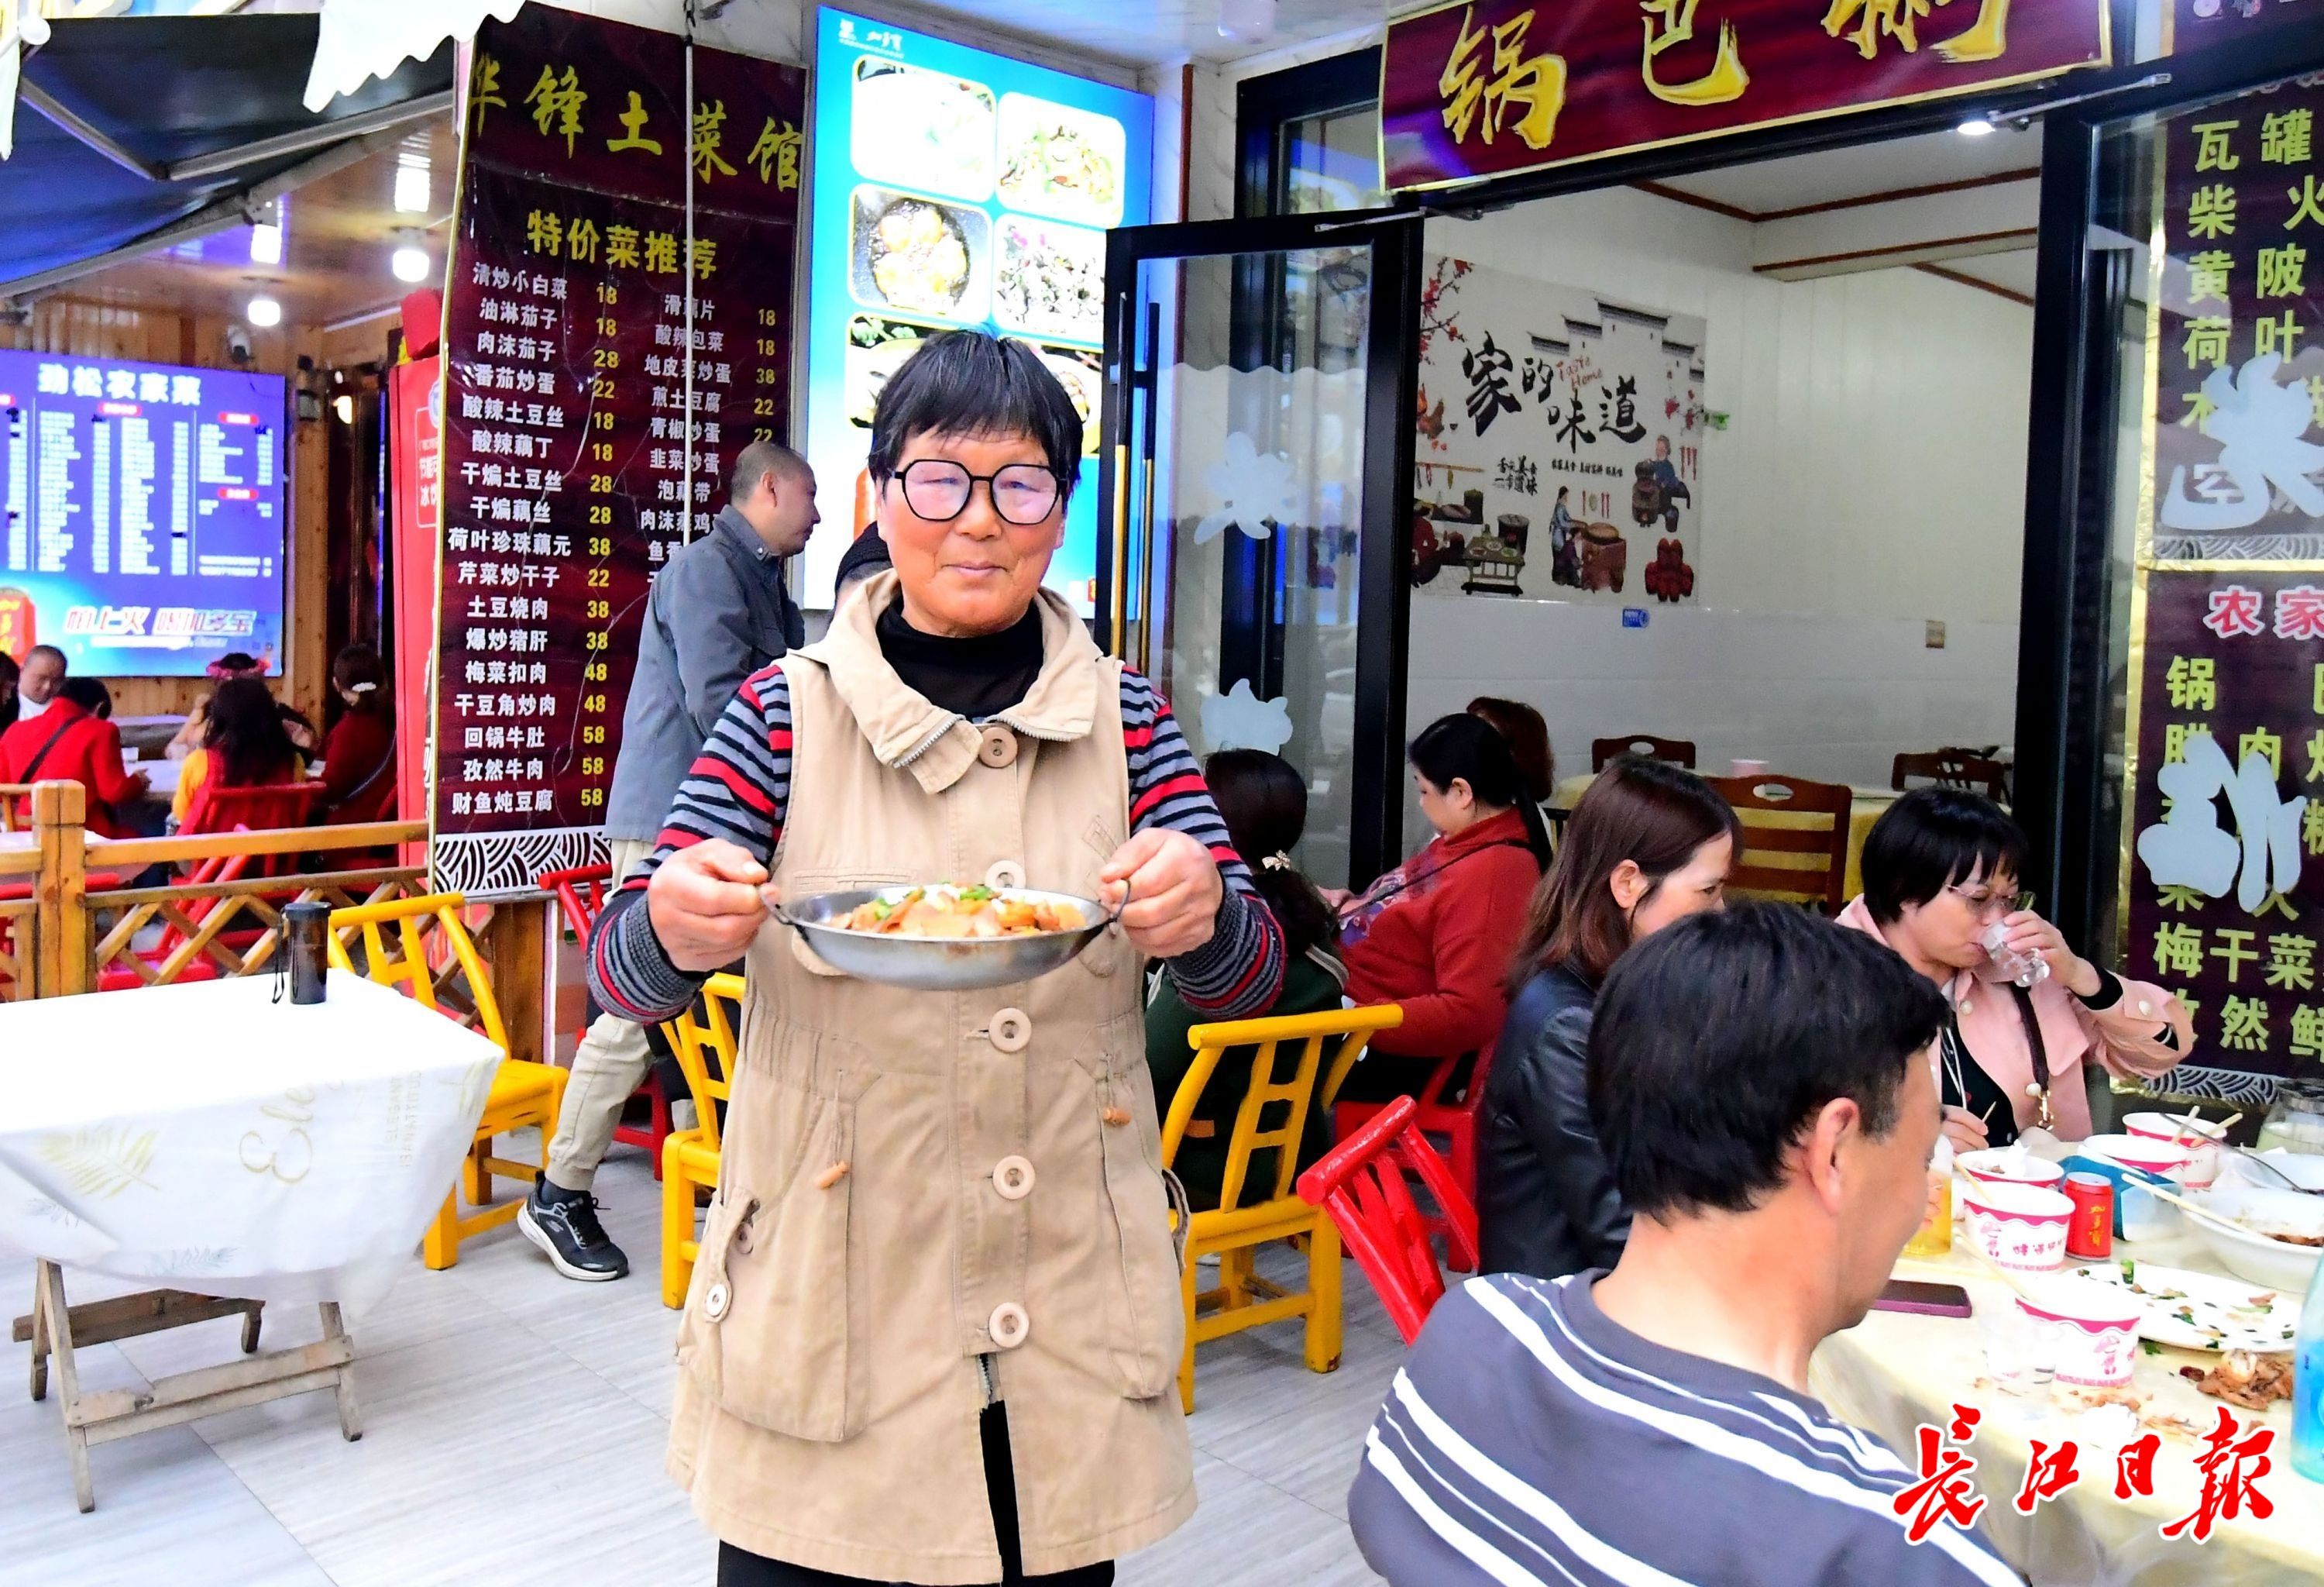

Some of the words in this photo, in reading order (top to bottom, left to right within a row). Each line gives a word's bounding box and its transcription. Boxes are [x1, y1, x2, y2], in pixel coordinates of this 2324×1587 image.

[471, 53, 803, 192] 华锋土菜馆
[2192, 108, 2312, 172] 瓦罐
[527, 209, 717, 279] 特价菜推荐
[473, 262, 568, 299] 清炒小白菜
[596, 282, 617, 305] 18
[2186, 243, 2306, 304] 黄陂
[480, 298, 558, 329] 油淋茄子
[596, 318, 617, 336] 18
[758, 308, 775, 326] 18
[477, 332, 555, 362] 肉沫茄子
[593, 349, 619, 369] 28
[655, 324, 724, 352] 酸辣包菜
[757, 339, 775, 356] 18
[2182, 310, 2304, 370] 荷叶
[475, 363, 555, 394] 番茄炒蛋
[594, 380, 615, 399] 22
[644, 354, 731, 383] 地皮菜炒蛋
[756, 367, 775, 384] 38
[651, 386, 721, 413] 煎土豆腐
[754, 398, 774, 415] 22
[1462, 329, 1646, 454] 家的味道
[462, 394, 564, 428] 酸辣土豆丝
[593, 411, 614, 430] 18
[651, 417, 720, 443] 青椒炒蛋
[472, 429, 552, 458] 酸辣藕丁
[593, 443, 613, 462] 18
[650, 448, 720, 473] 韭菜炒蛋
[461, 462, 562, 492] 干煸土豆丝
[590, 475, 612, 493] 28
[470, 497, 551, 523] 干煸藕丝
[590, 506, 611, 524] 28
[641, 508, 720, 533] 肉沫蒸鸡
[449, 527, 572, 556] 荷叶珍珠藕元
[589, 538, 610, 556] 38
[458, 561, 560, 588] 芹菜炒干子
[588, 569, 610, 587] 22
[467, 595, 548, 620] 土豆烧肉
[587, 601, 609, 618] 38
[466, 628, 548, 652] 爆炒猪肝
[586, 632, 608, 650] 38
[466, 660, 546, 684] 梅菜扣肉
[585, 663, 607, 681] 48
[454, 694, 556, 717] 干豆角炒肉
[584, 694, 606, 712] 48
[465, 726, 545, 749] 回锅牛肚
[583, 726, 605, 744] 58
[463, 759, 544, 782] 孜然牛肉
[583, 757, 604, 775] 58
[452, 788, 553, 814] 财鱼炖豆腐
[581, 788, 603, 807] 58
